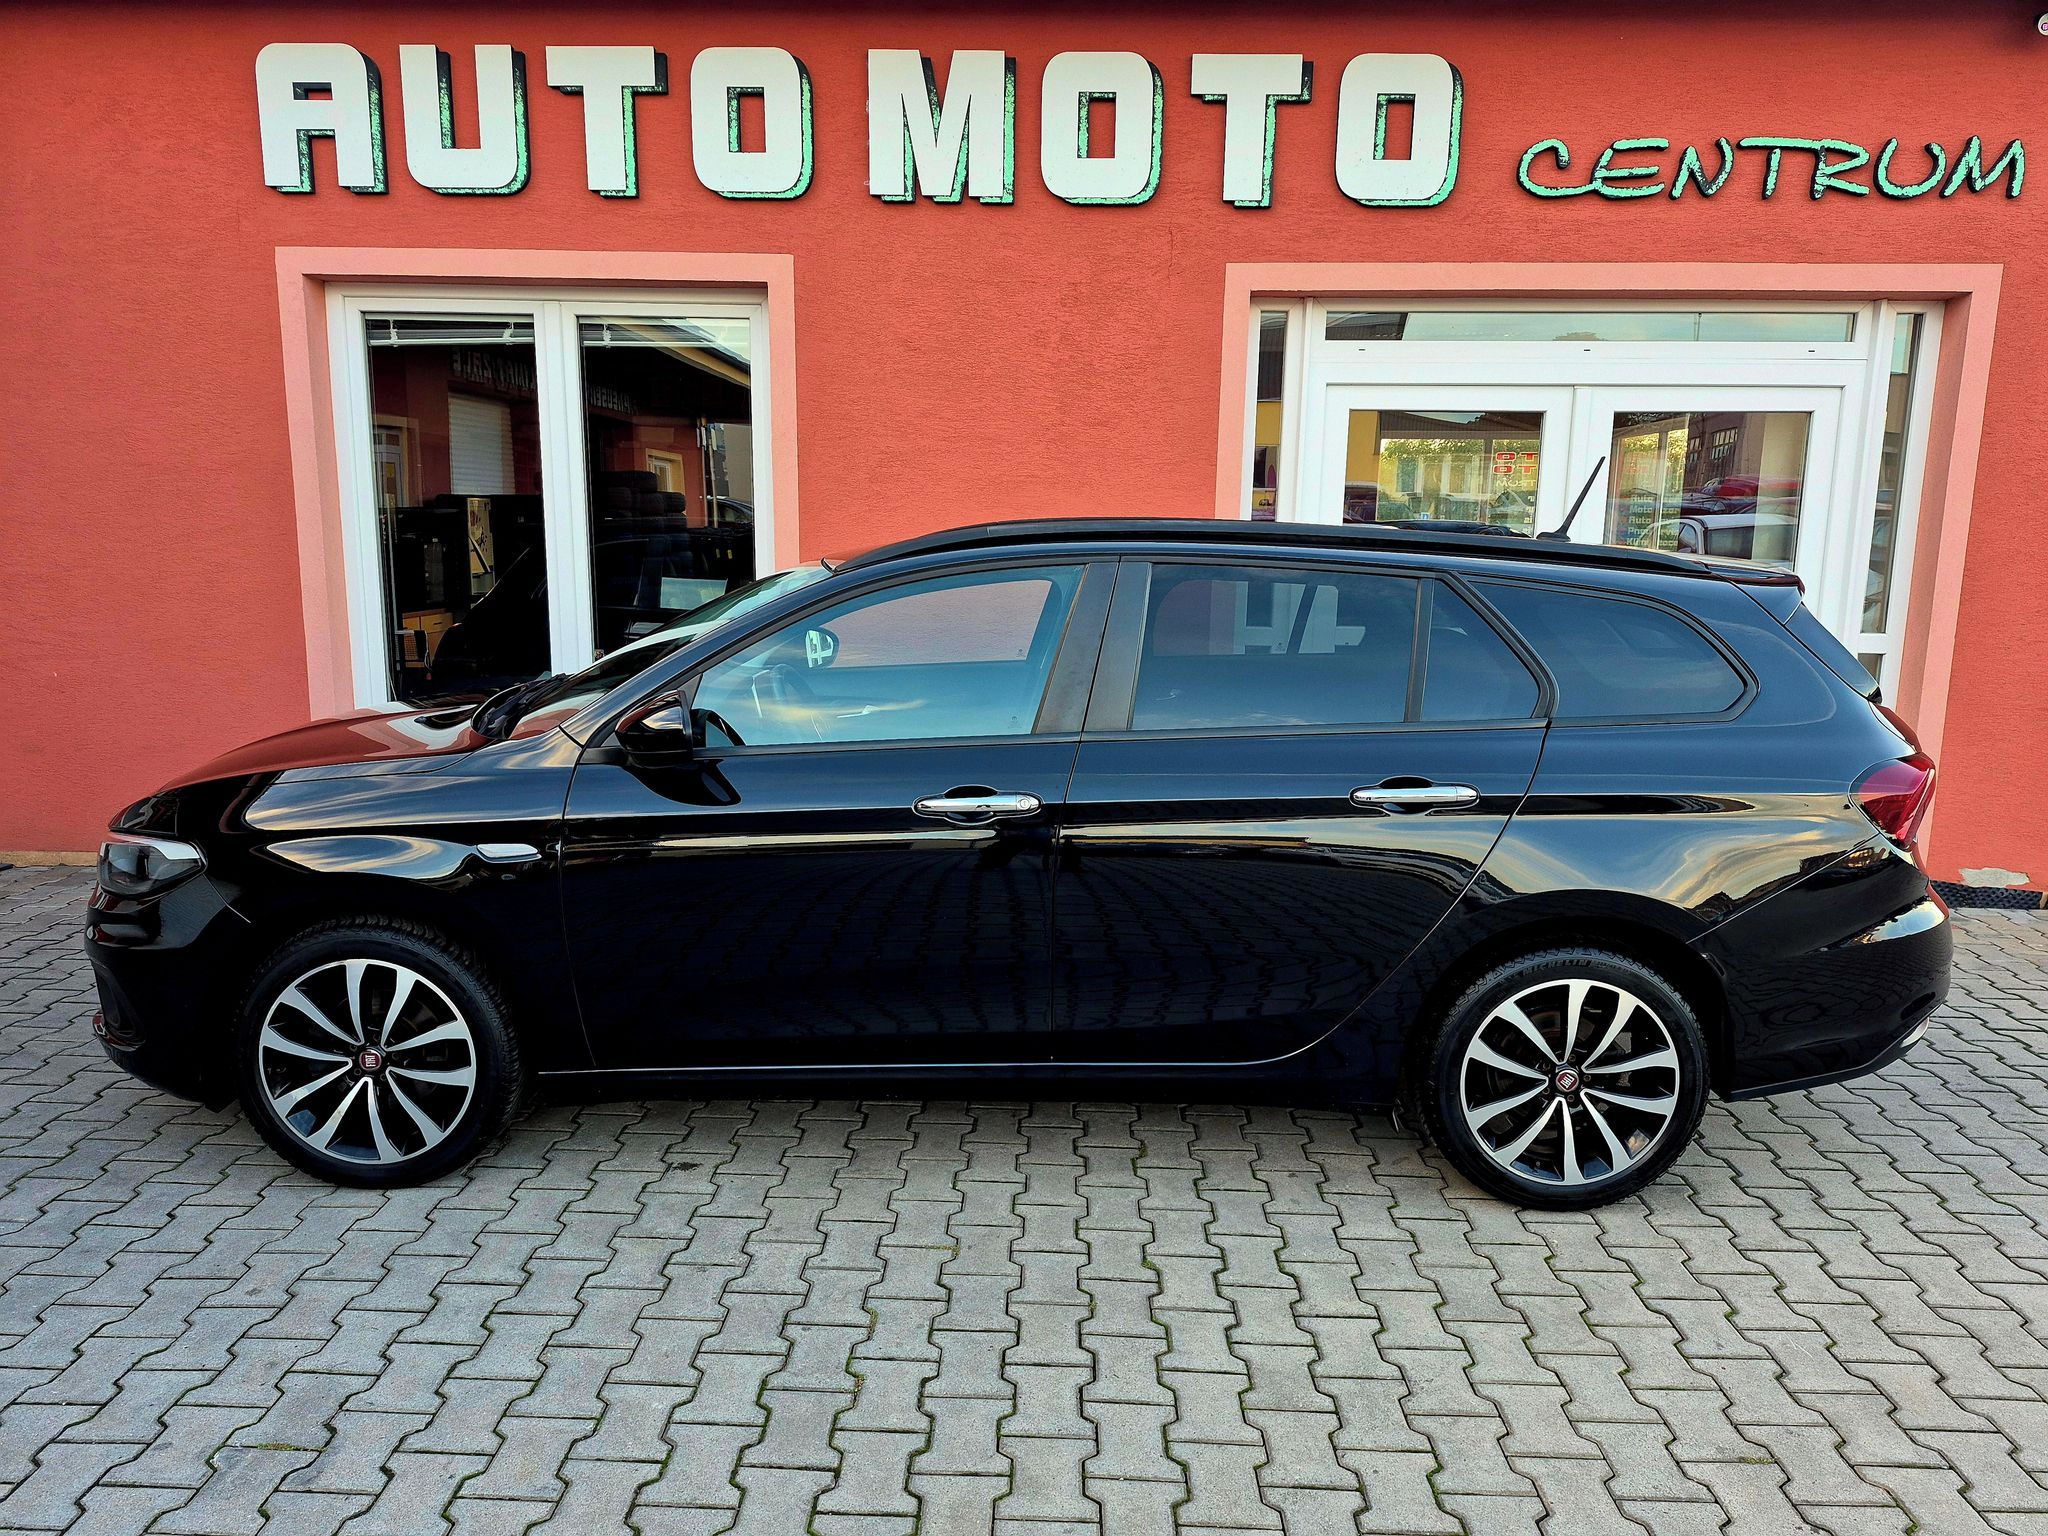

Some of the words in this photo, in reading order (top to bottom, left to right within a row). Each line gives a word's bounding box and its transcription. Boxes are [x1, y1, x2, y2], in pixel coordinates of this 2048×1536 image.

[255, 43, 814, 199] AUTO
[867, 48, 1464, 208] MOTO
[1516, 135, 2027, 202] CENTRUM
